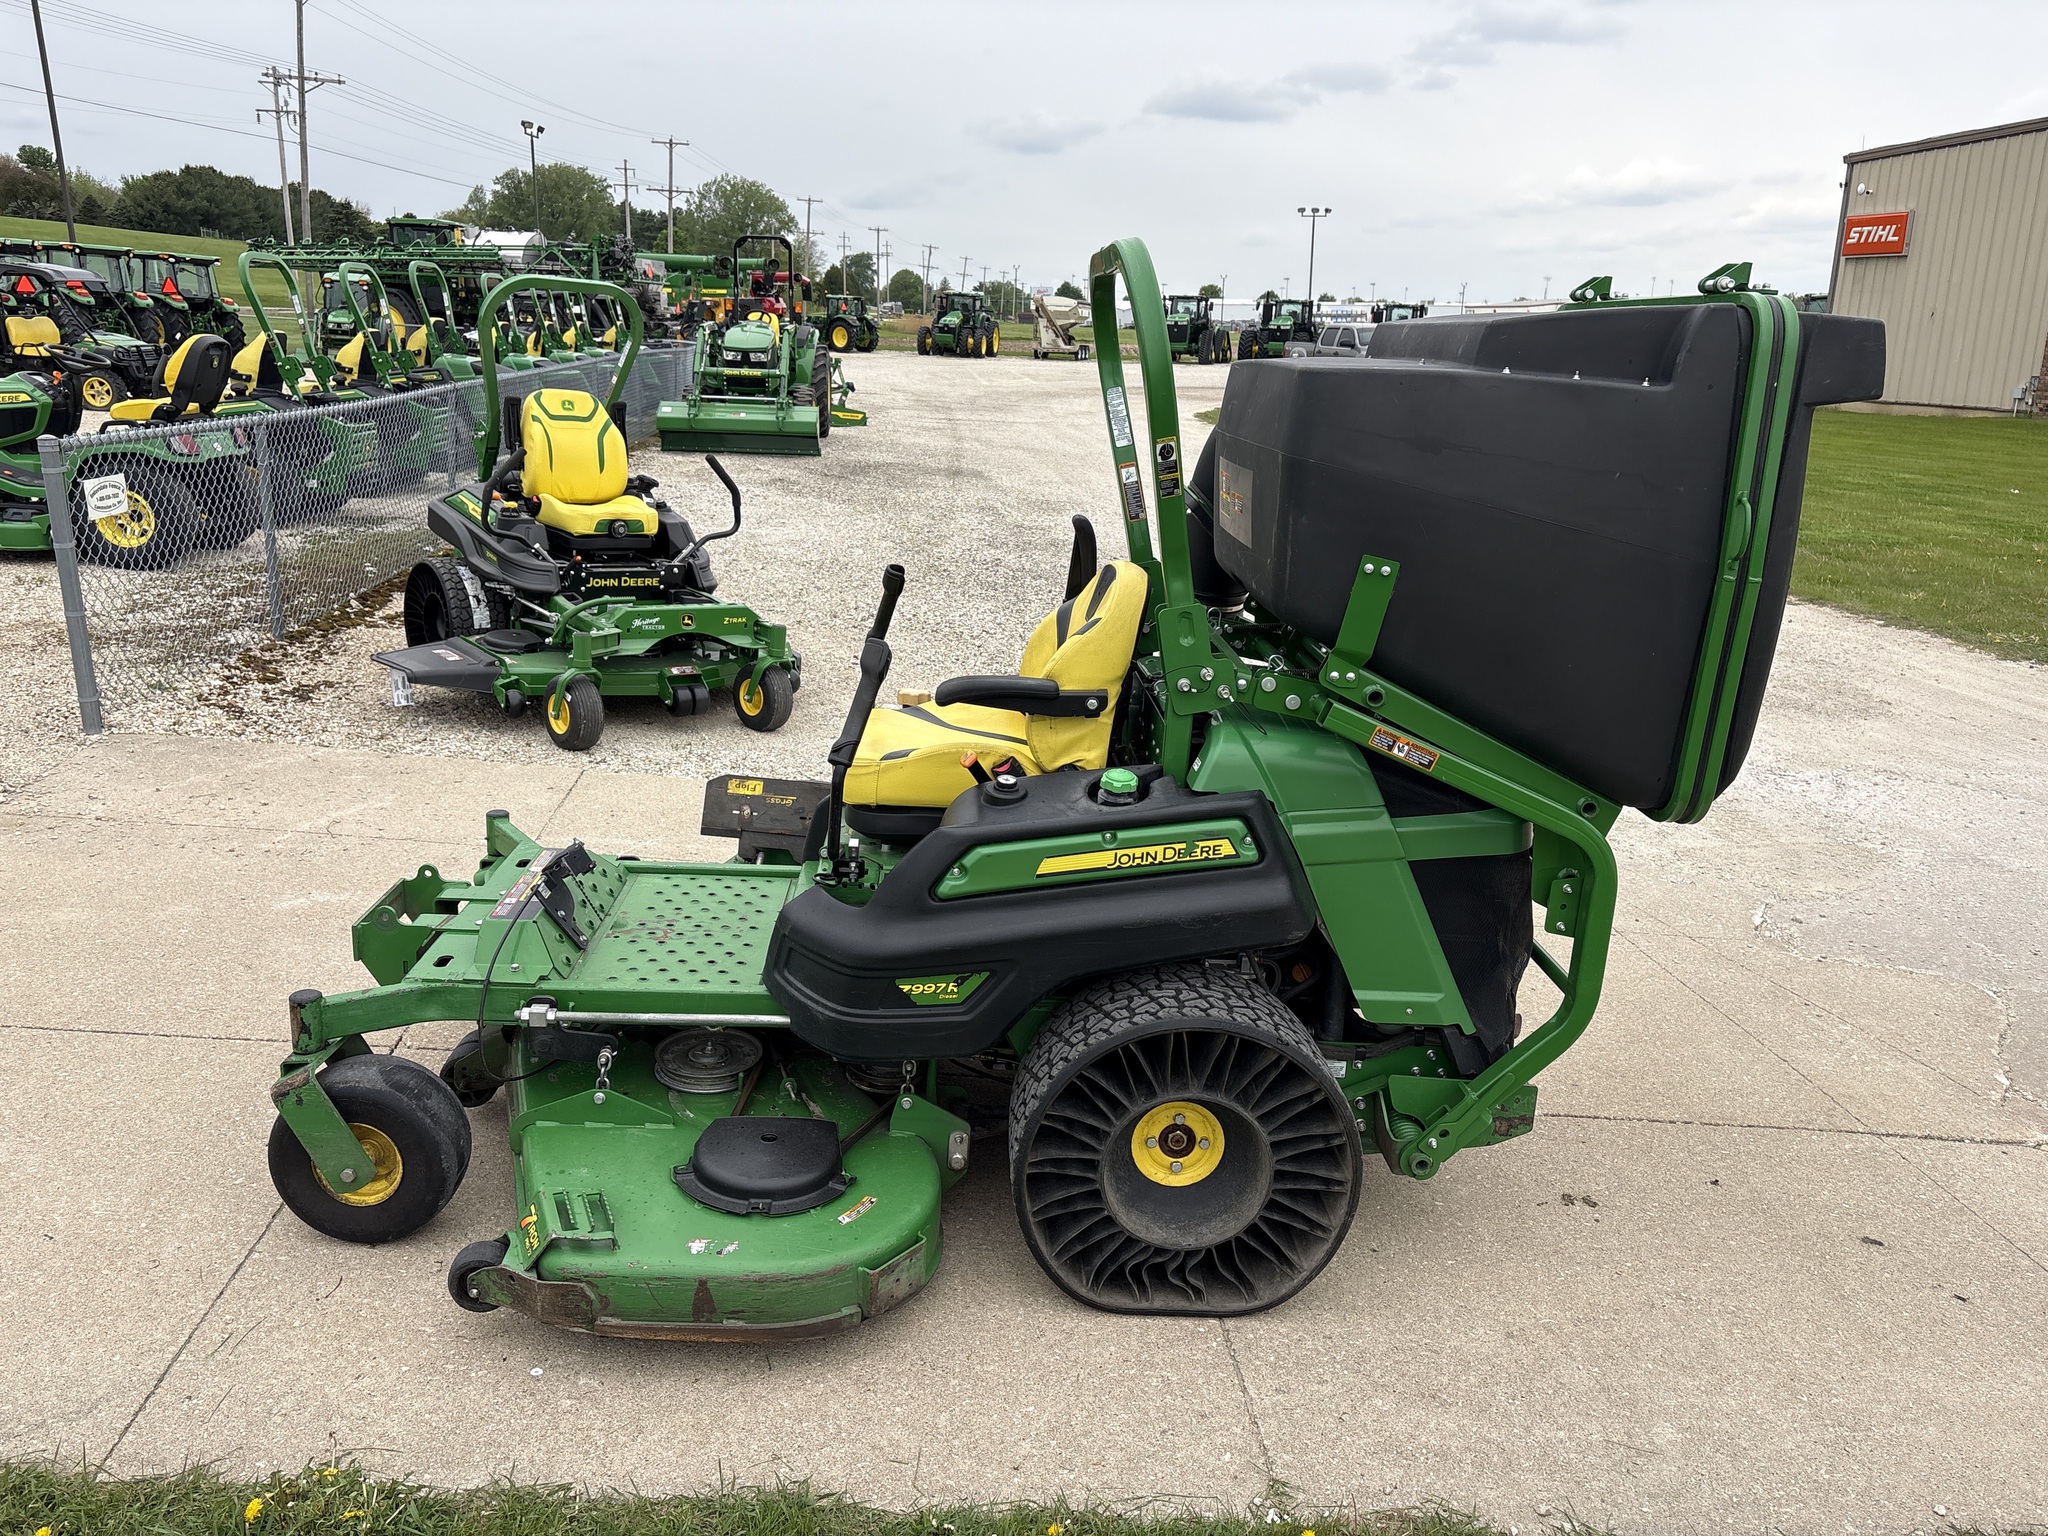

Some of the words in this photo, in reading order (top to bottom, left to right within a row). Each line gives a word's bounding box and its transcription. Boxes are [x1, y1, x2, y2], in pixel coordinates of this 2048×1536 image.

[1846, 224, 1899, 244] STIHL
[585, 576, 619, 587] JOHN
[621, 576, 660, 587] DEERE
[734, 782, 758, 792] Flap
[765, 797, 795, 807] Grass
[1106, 850, 1158, 867] JOHN
